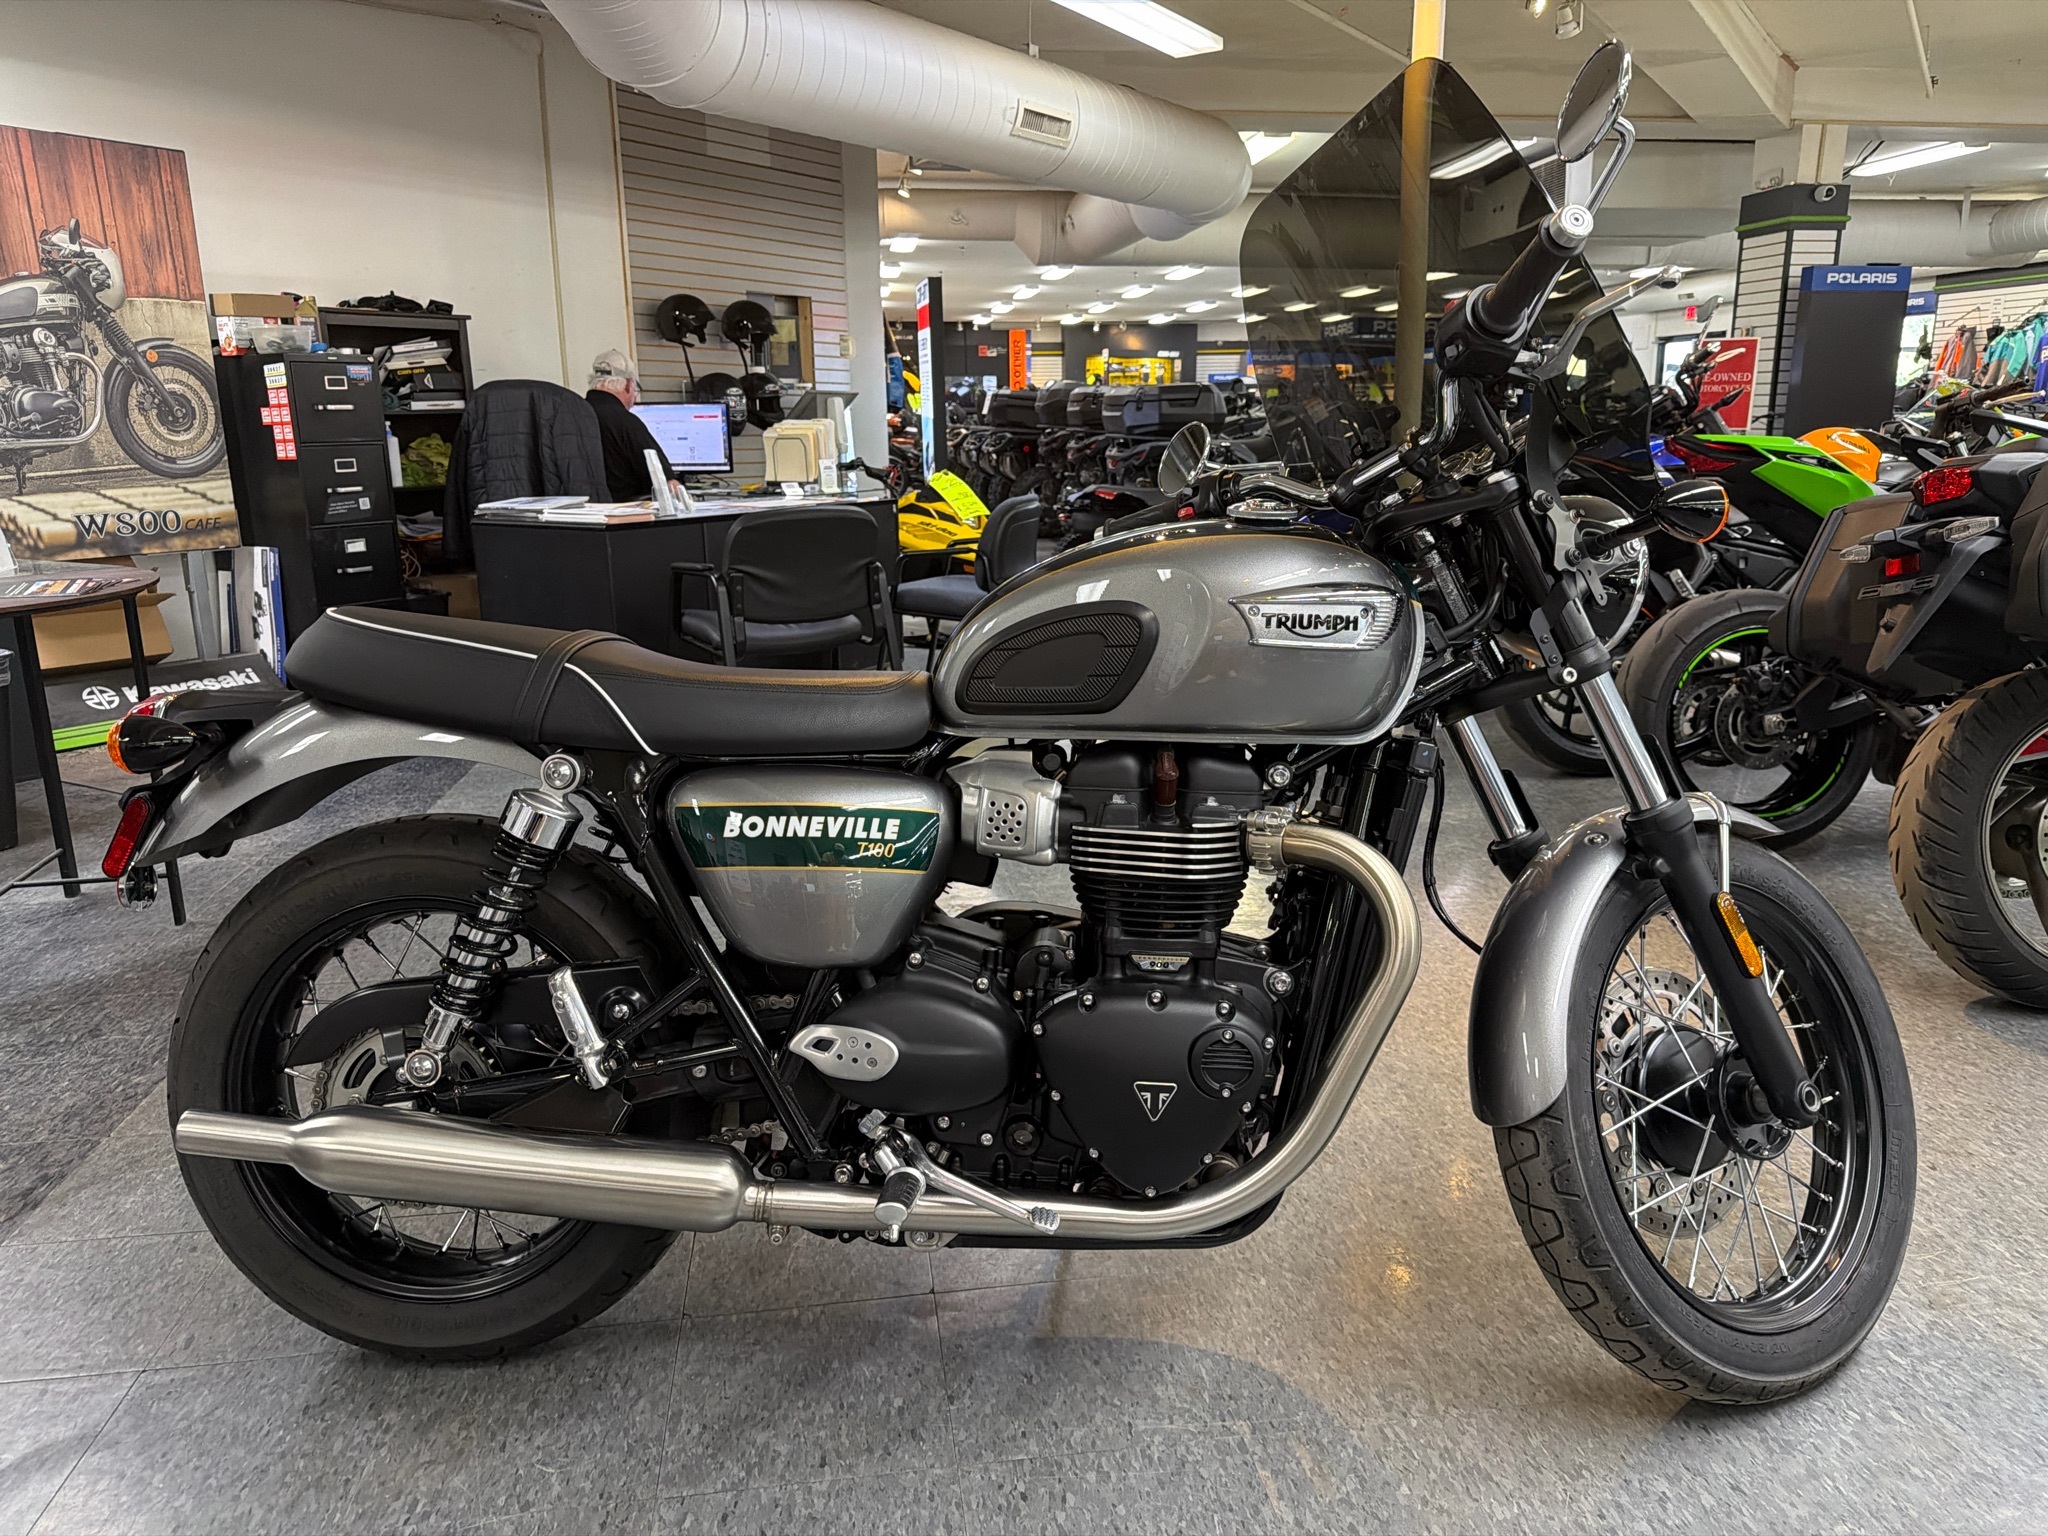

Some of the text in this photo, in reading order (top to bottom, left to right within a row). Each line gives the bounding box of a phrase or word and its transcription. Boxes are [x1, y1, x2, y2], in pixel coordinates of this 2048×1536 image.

[1827, 273, 1898, 284] POLARIS
[1324, 322, 1354, 337] POLARIS
[1704, 372, 1752, 382] E-OWNED
[1826, 434, 1870, 454] Kwasaki
[185, 517, 221, 531] CAFE
[1261, 612, 1359, 638] TRIUMPH
[723, 815, 901, 840] BONNEVILLE
[857, 841, 896, 858] T100
[1149, 961, 1170, 969] 900
